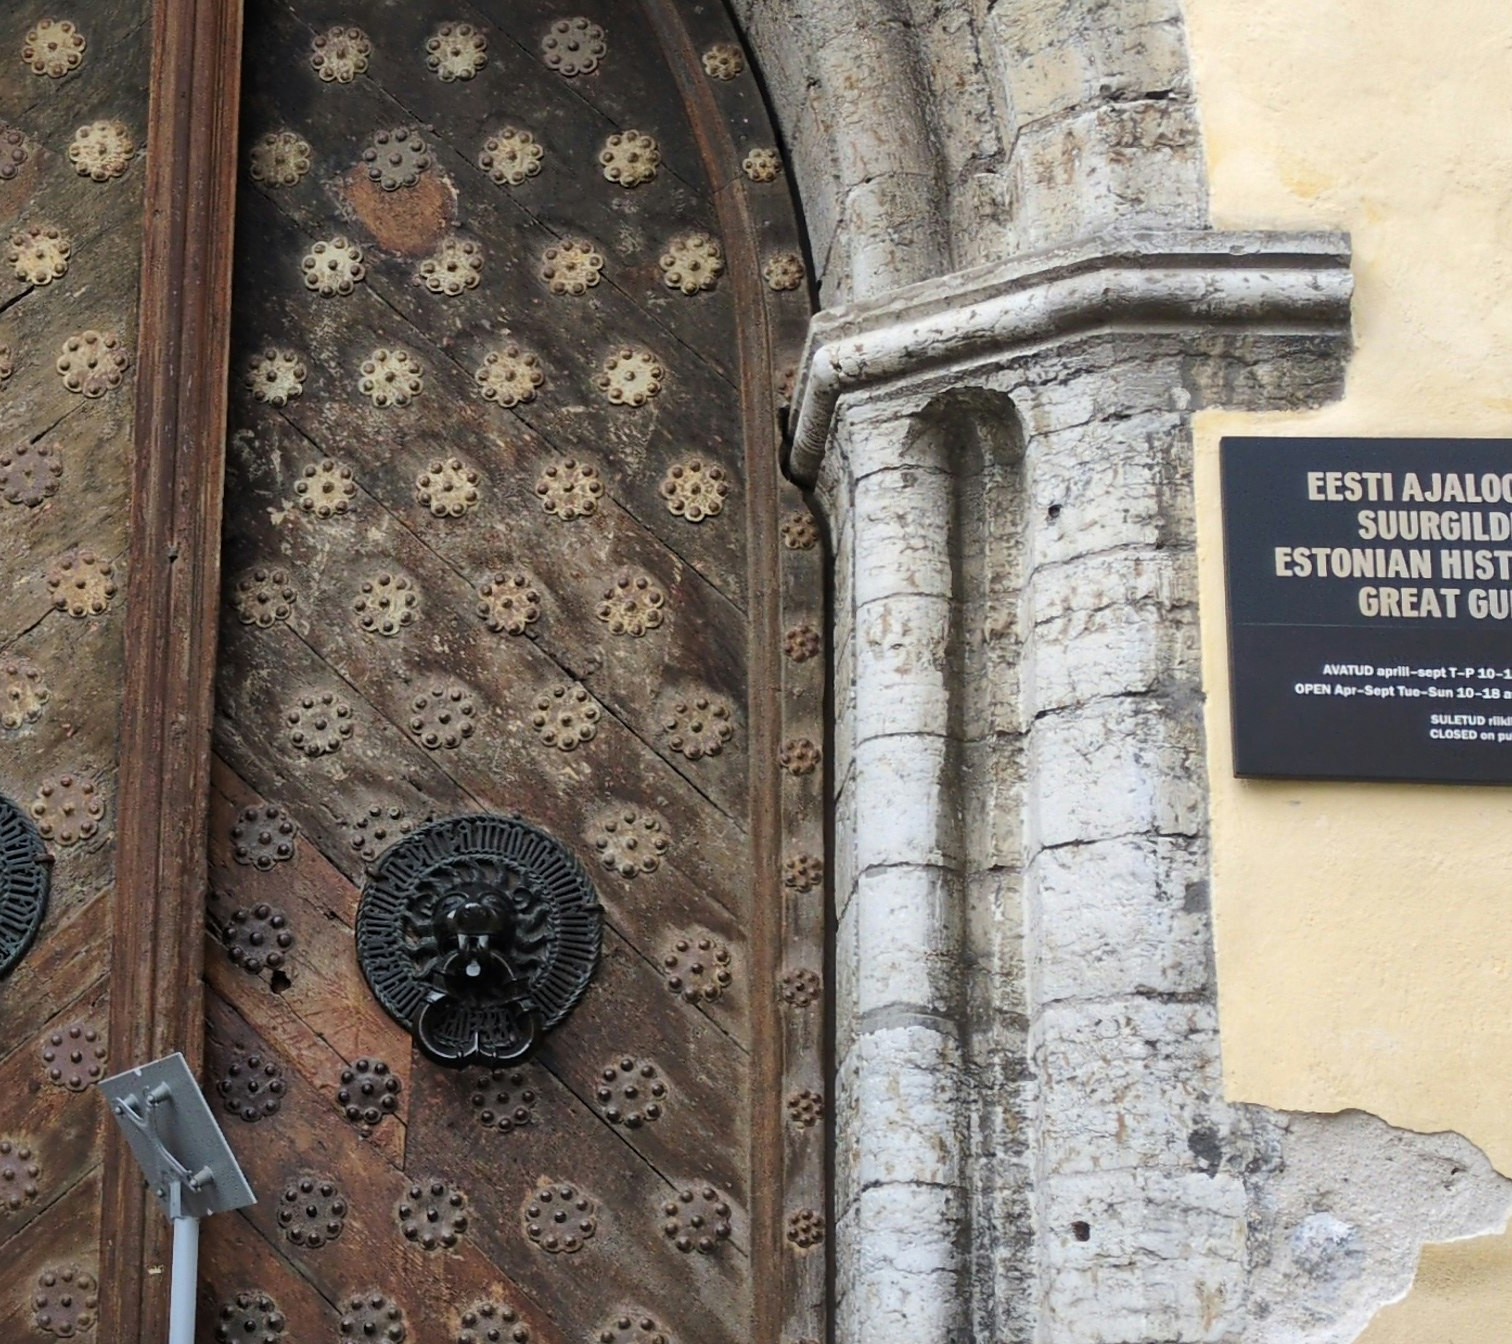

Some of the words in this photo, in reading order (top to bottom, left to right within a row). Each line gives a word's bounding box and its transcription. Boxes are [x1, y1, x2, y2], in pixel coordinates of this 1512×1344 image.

[1307, 471, 1393, 502] EESTI
[1357, 510, 1512, 542] SUURGILD
[1275, 547, 1432, 579] ESTONIAN
[1440, 549, 1512, 581] HIST
[1358, 586, 1460, 618] GREAT
[1468, 588, 1512, 620] GU
[1322, 664, 1374, 676] AVATUD
[1294, 683, 1331, 695] OPEN
[1430, 714, 1486, 726] SULETUD
[1429, 728, 1478, 740] CLOSED
[1480, 731, 1495, 741] on
